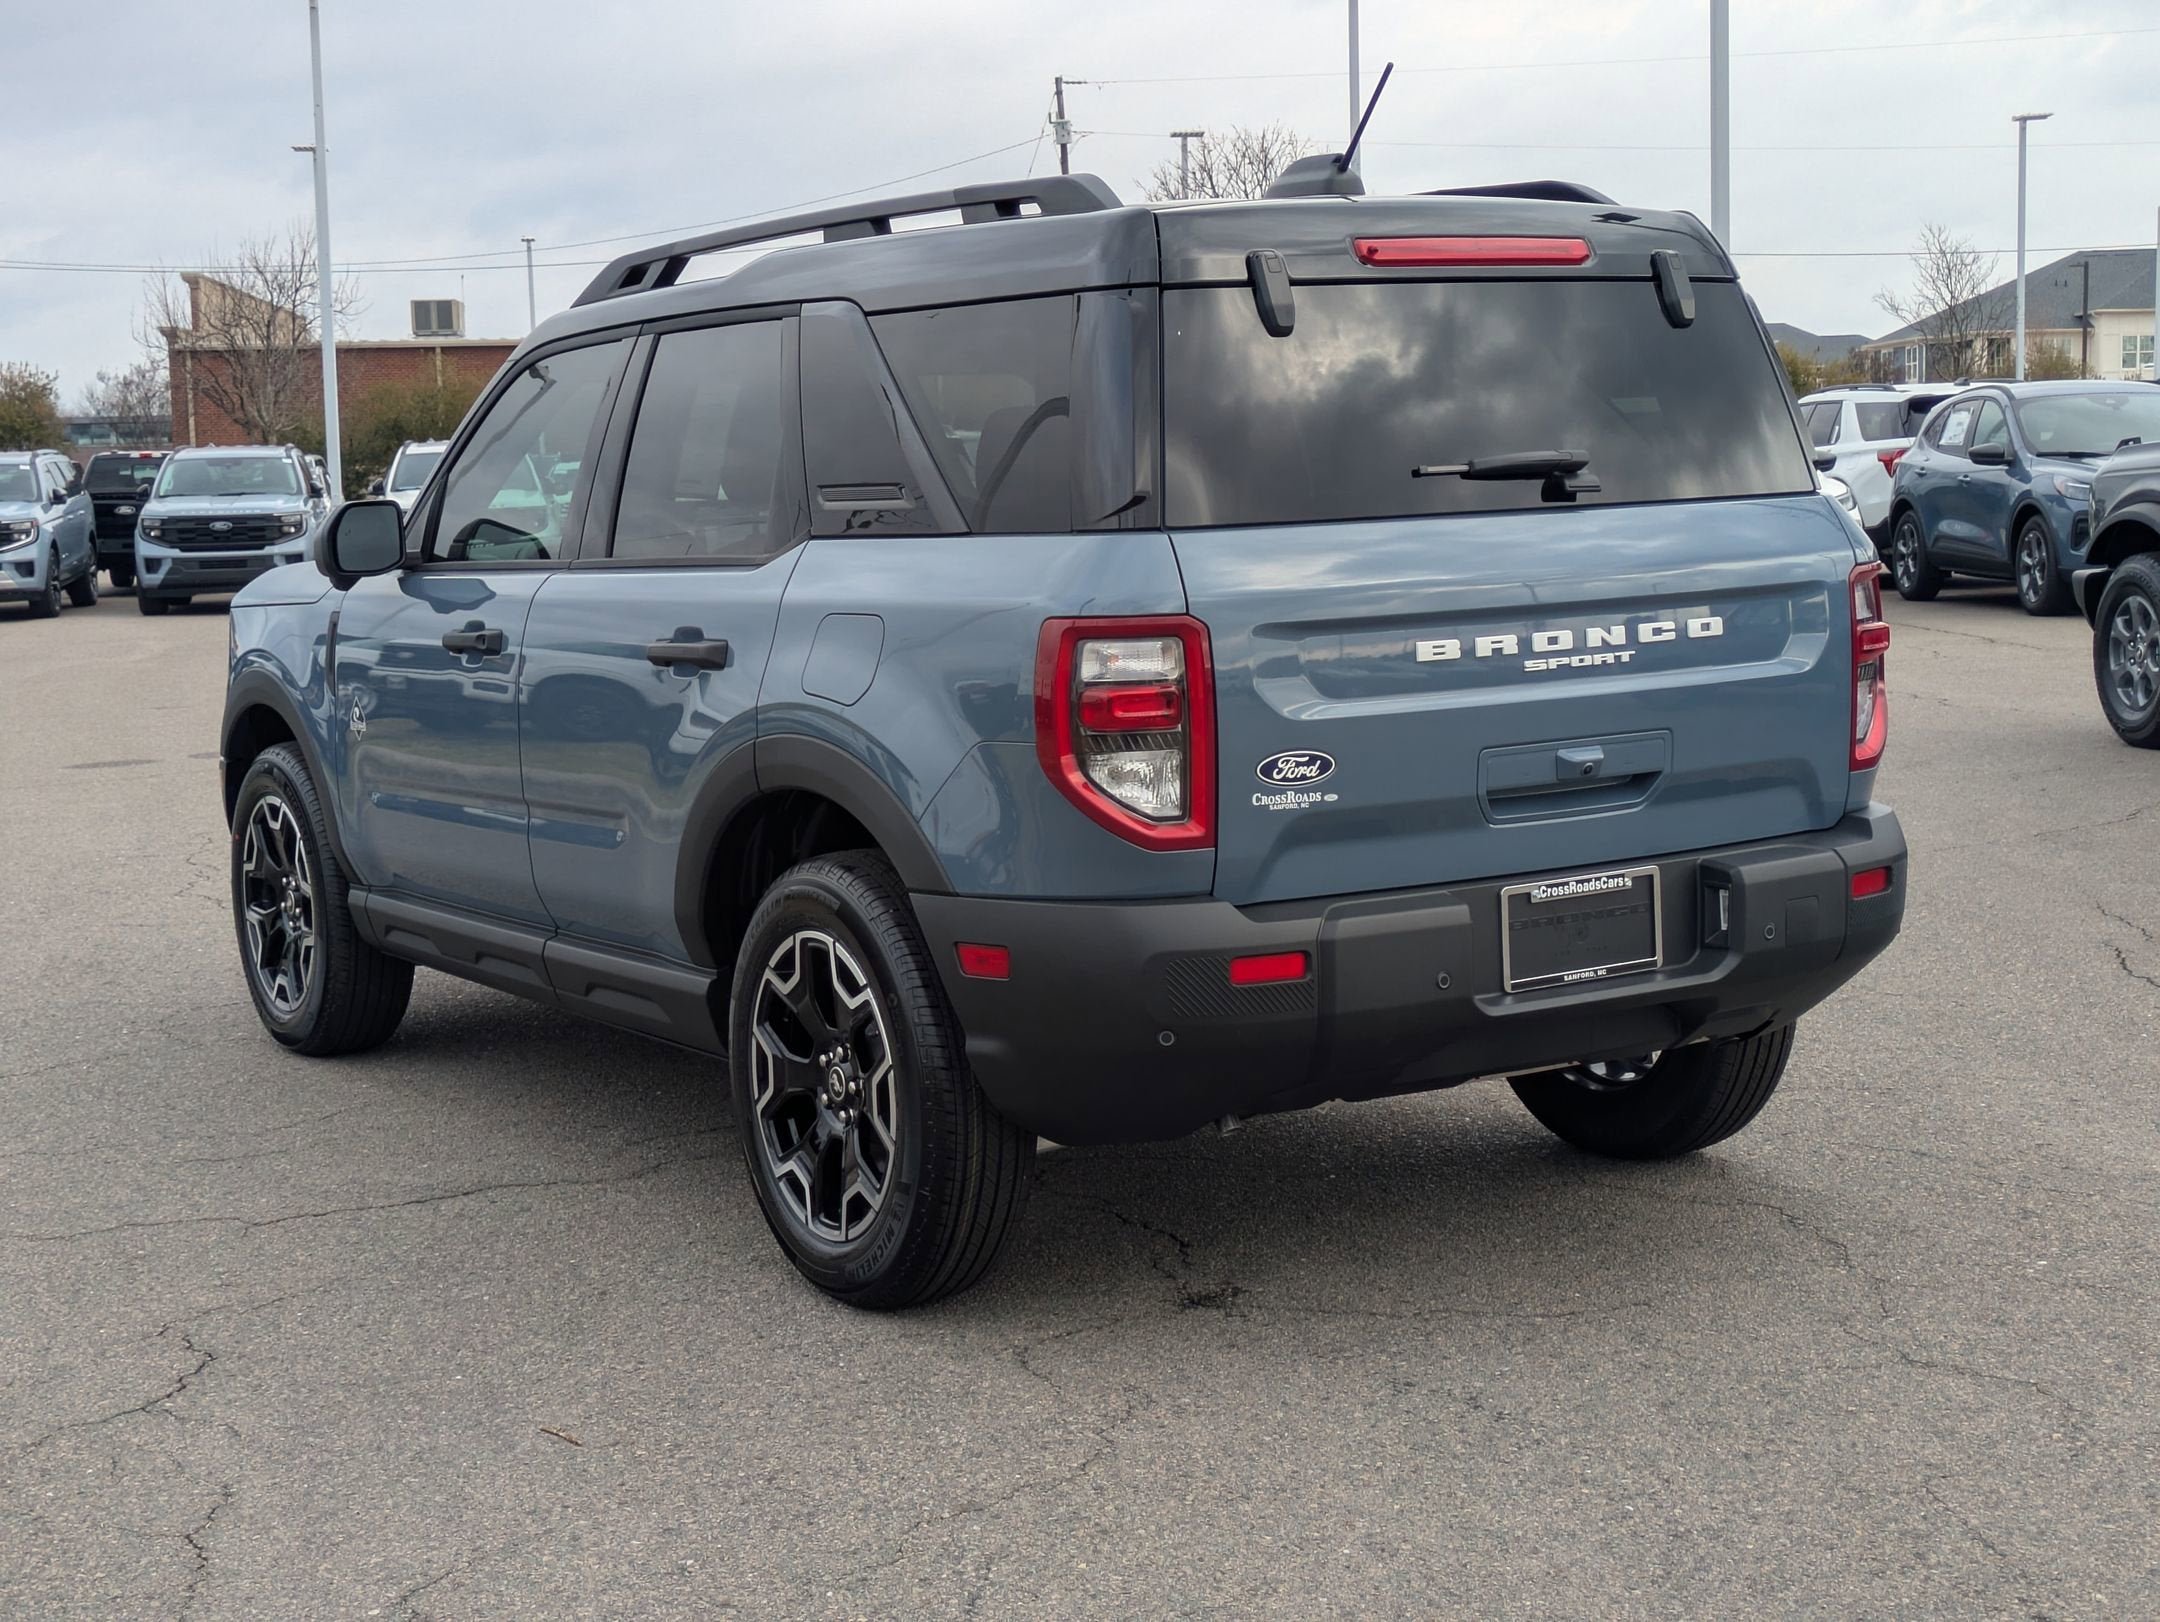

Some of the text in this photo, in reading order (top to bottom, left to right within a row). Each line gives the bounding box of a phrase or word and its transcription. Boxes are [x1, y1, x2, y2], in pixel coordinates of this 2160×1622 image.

[1415, 616, 1724, 662] BRONCO
[1523, 650, 1636, 672] SPORT
[1272, 756, 1321, 779] Ford
[1538, 876, 1624, 899] CrossRoadsCars
